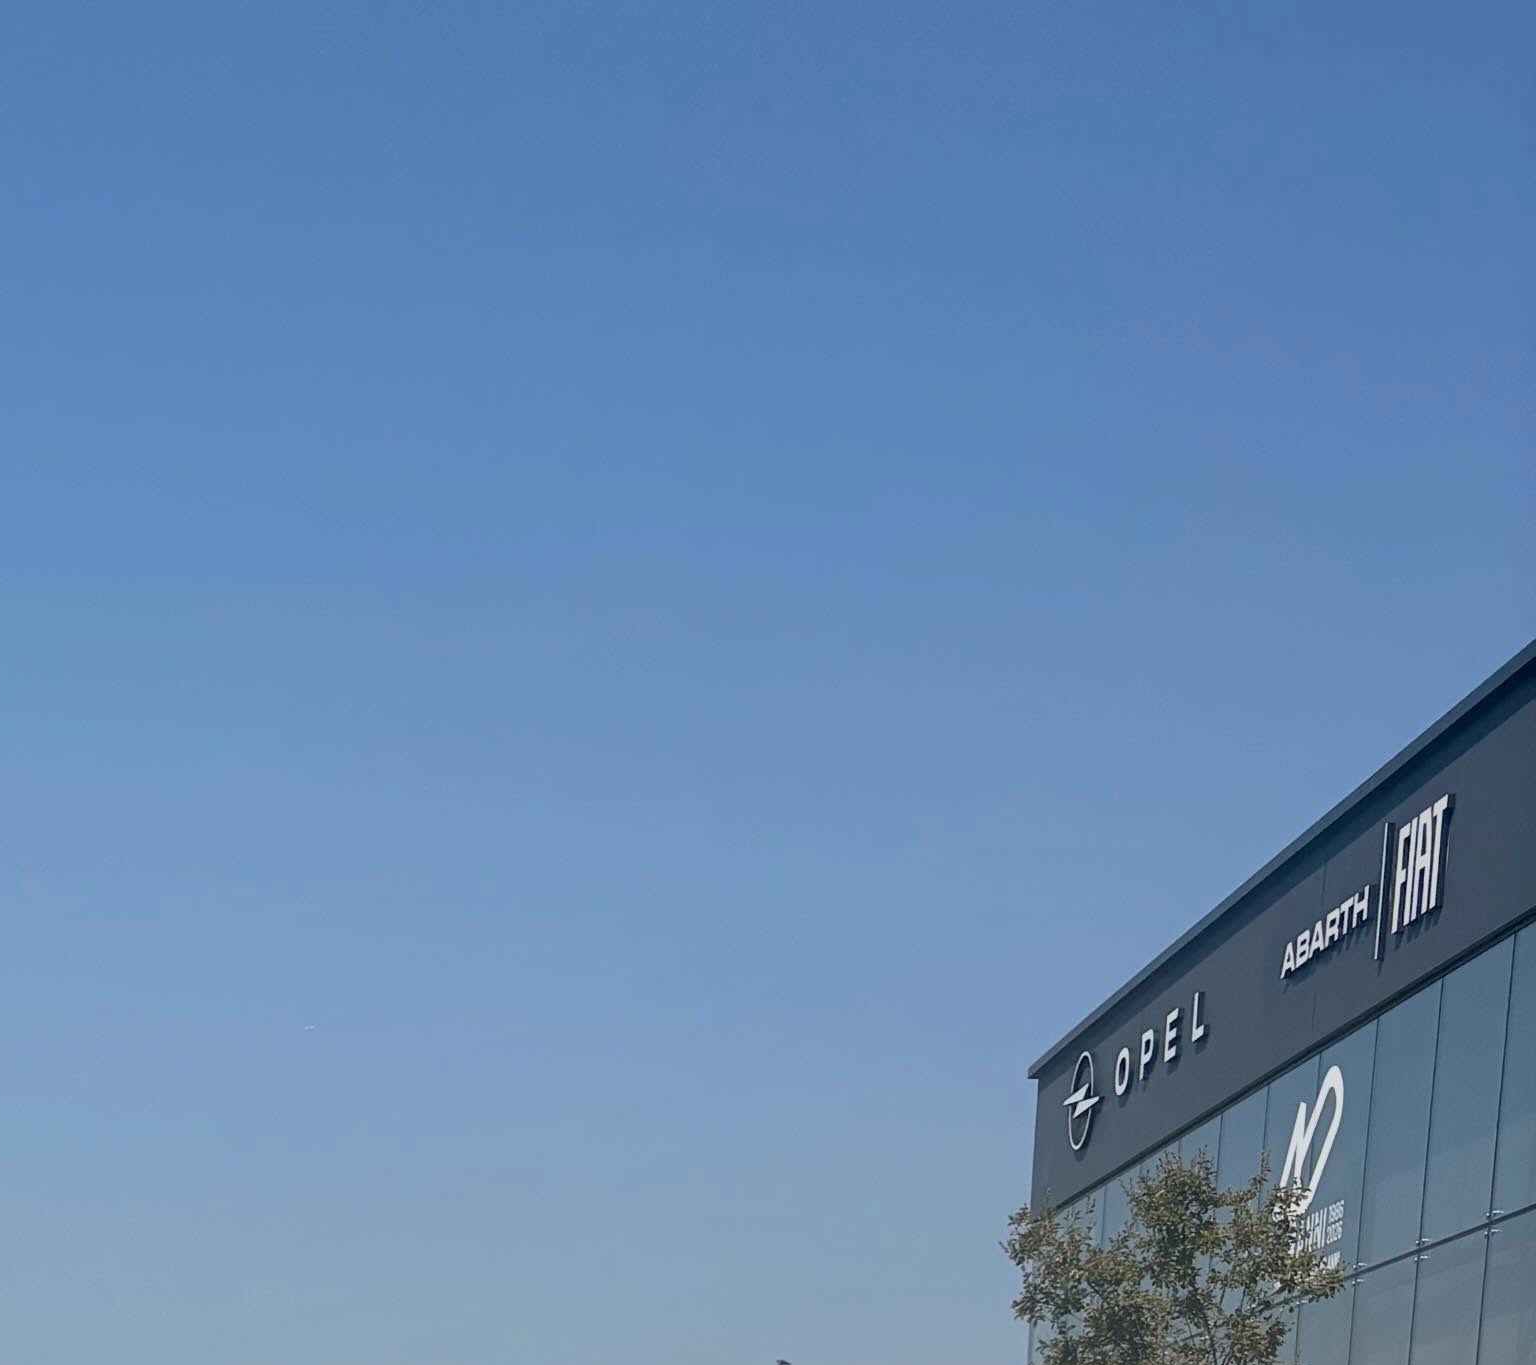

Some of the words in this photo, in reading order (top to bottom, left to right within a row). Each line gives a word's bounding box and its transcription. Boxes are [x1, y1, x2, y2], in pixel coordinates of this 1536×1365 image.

[1391, 794, 1449, 935] FIAT
[1280, 885, 1370, 980] ABARTH
[1114, 992, 1206, 1096] OPEL
